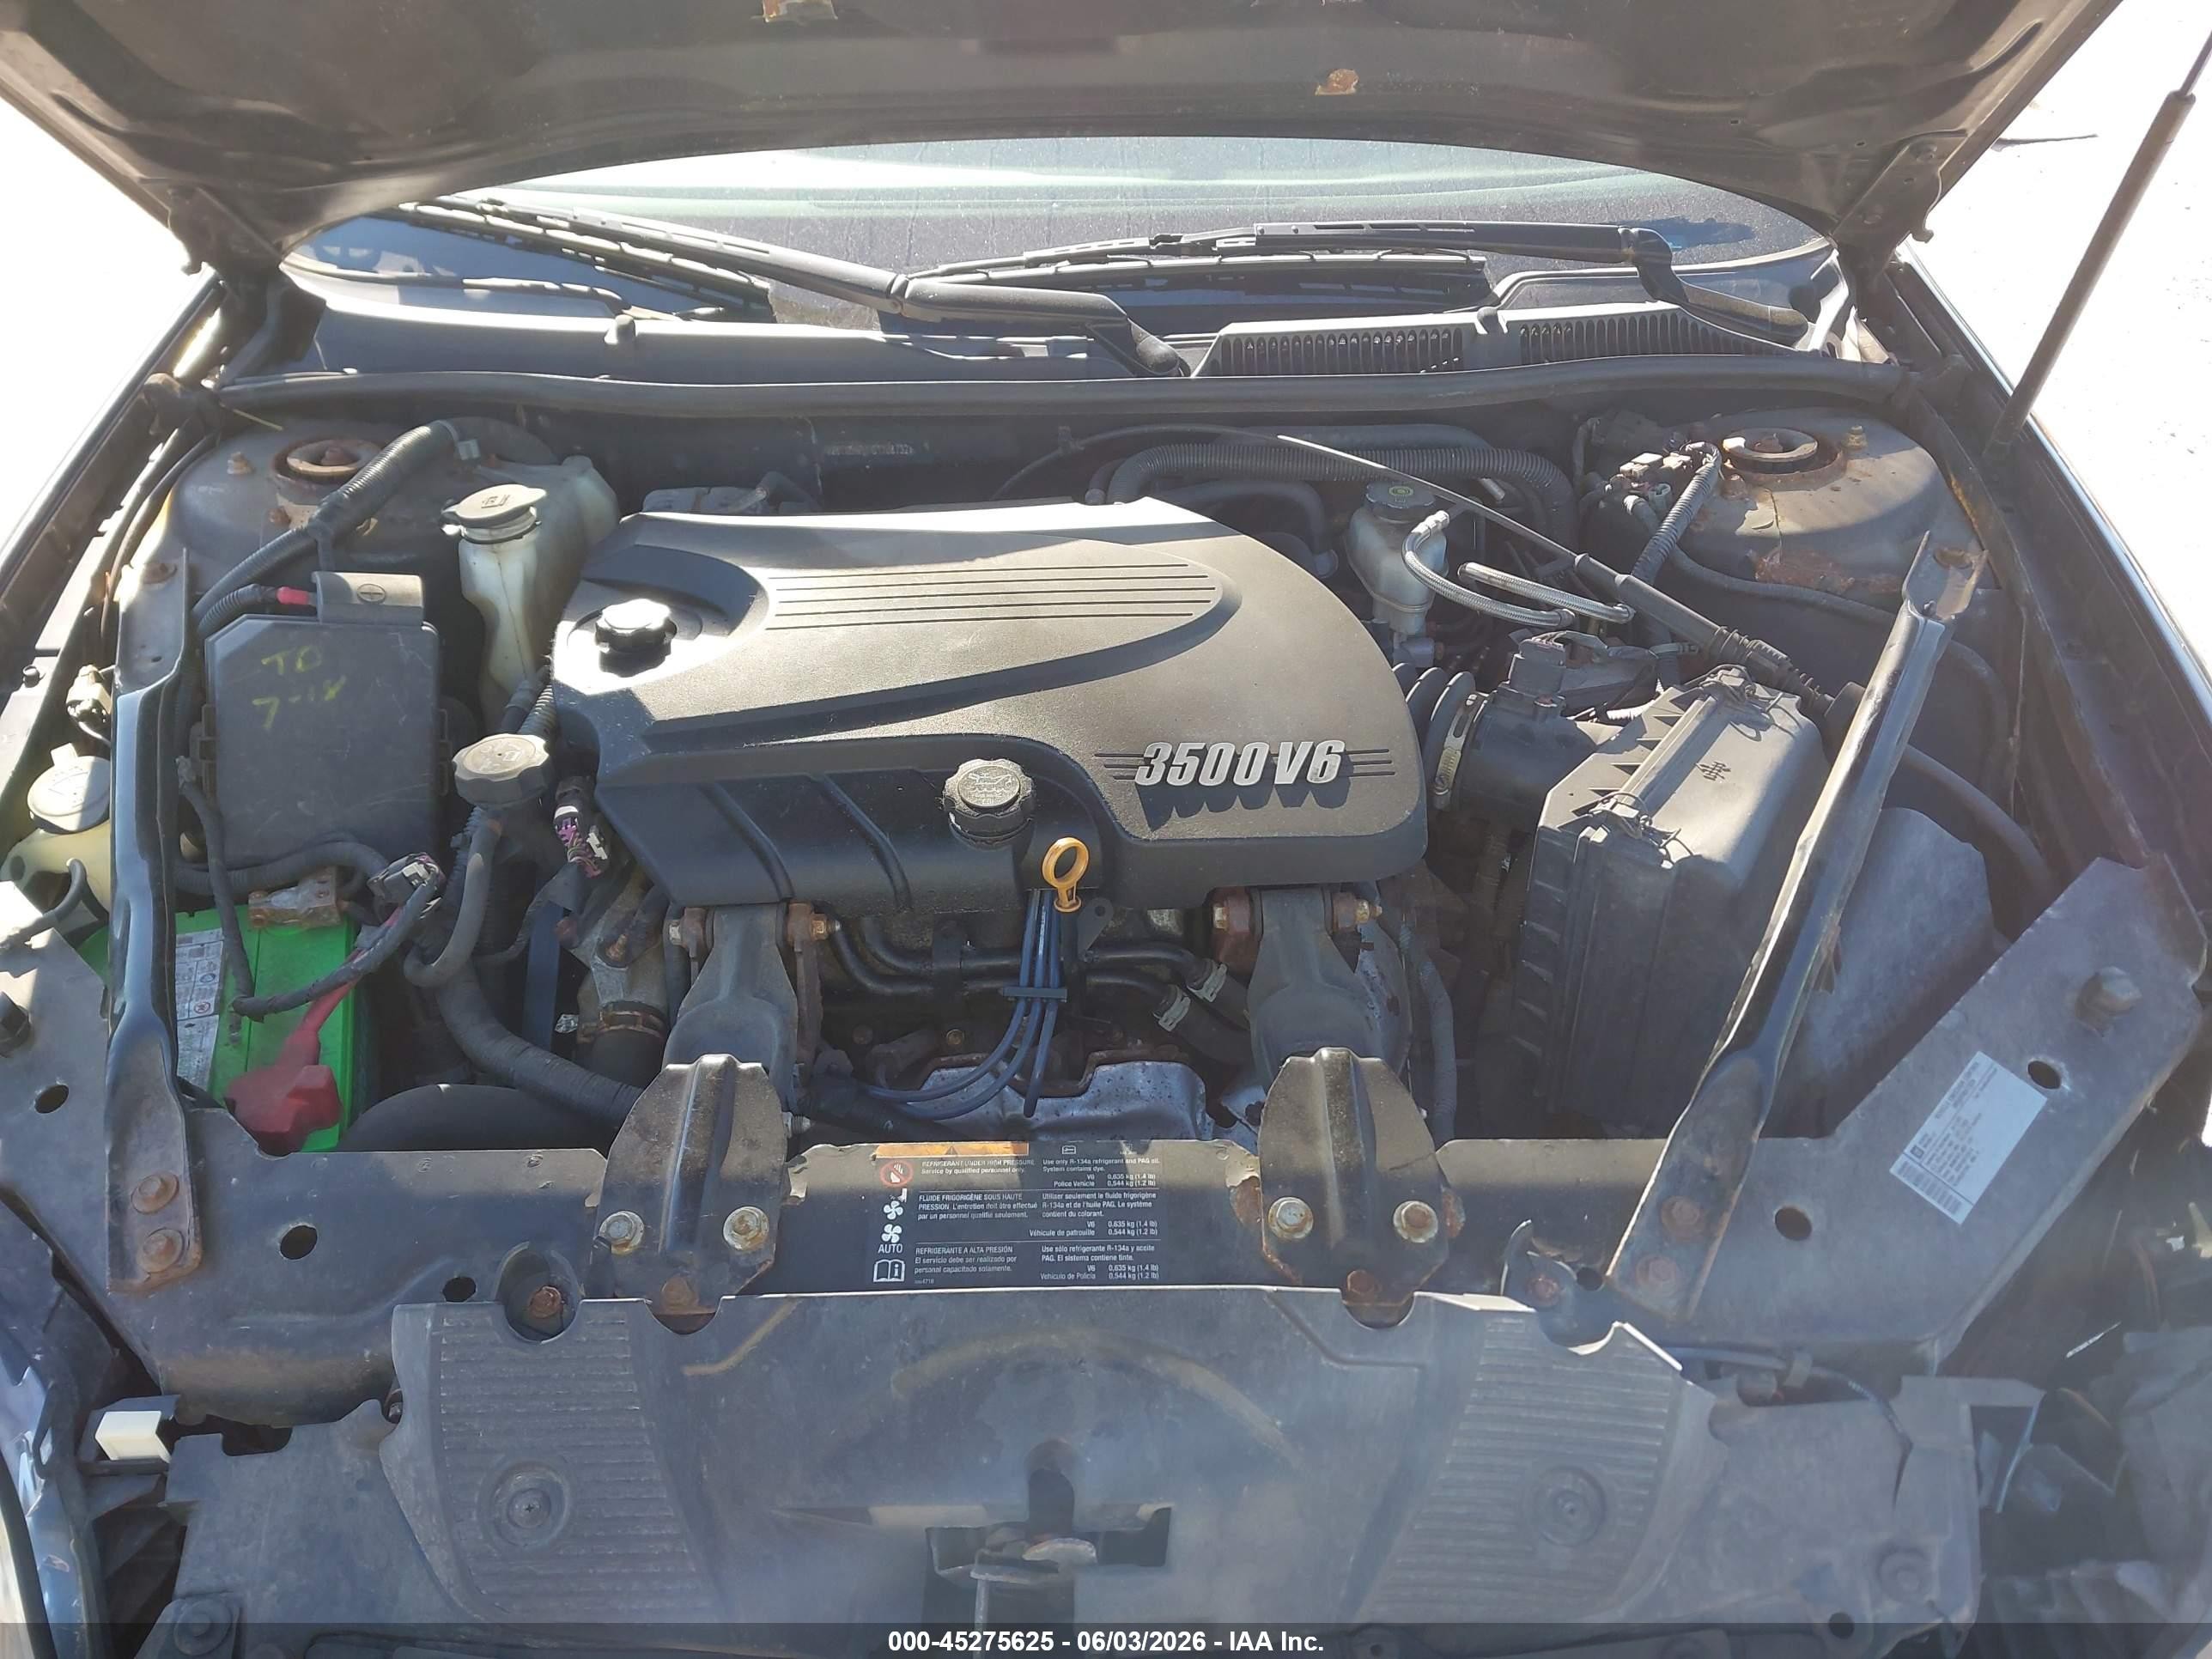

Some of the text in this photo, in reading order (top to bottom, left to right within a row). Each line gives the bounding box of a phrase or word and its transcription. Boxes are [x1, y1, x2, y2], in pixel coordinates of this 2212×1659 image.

[953, 1167, 980, 1176] qualified
[1127, 1220, 1134, 1229] kg
[1066, 1229, 1096, 1237] patrouille
[878, 1244, 903, 1254] AUTO
[1069, 1245, 1105, 1254] refrigerante
[915, 1266, 941, 1274] personal
[1137, 1264, 1150, 1273] (1.4
[1137, 1272, 1150, 1280] (1.2
